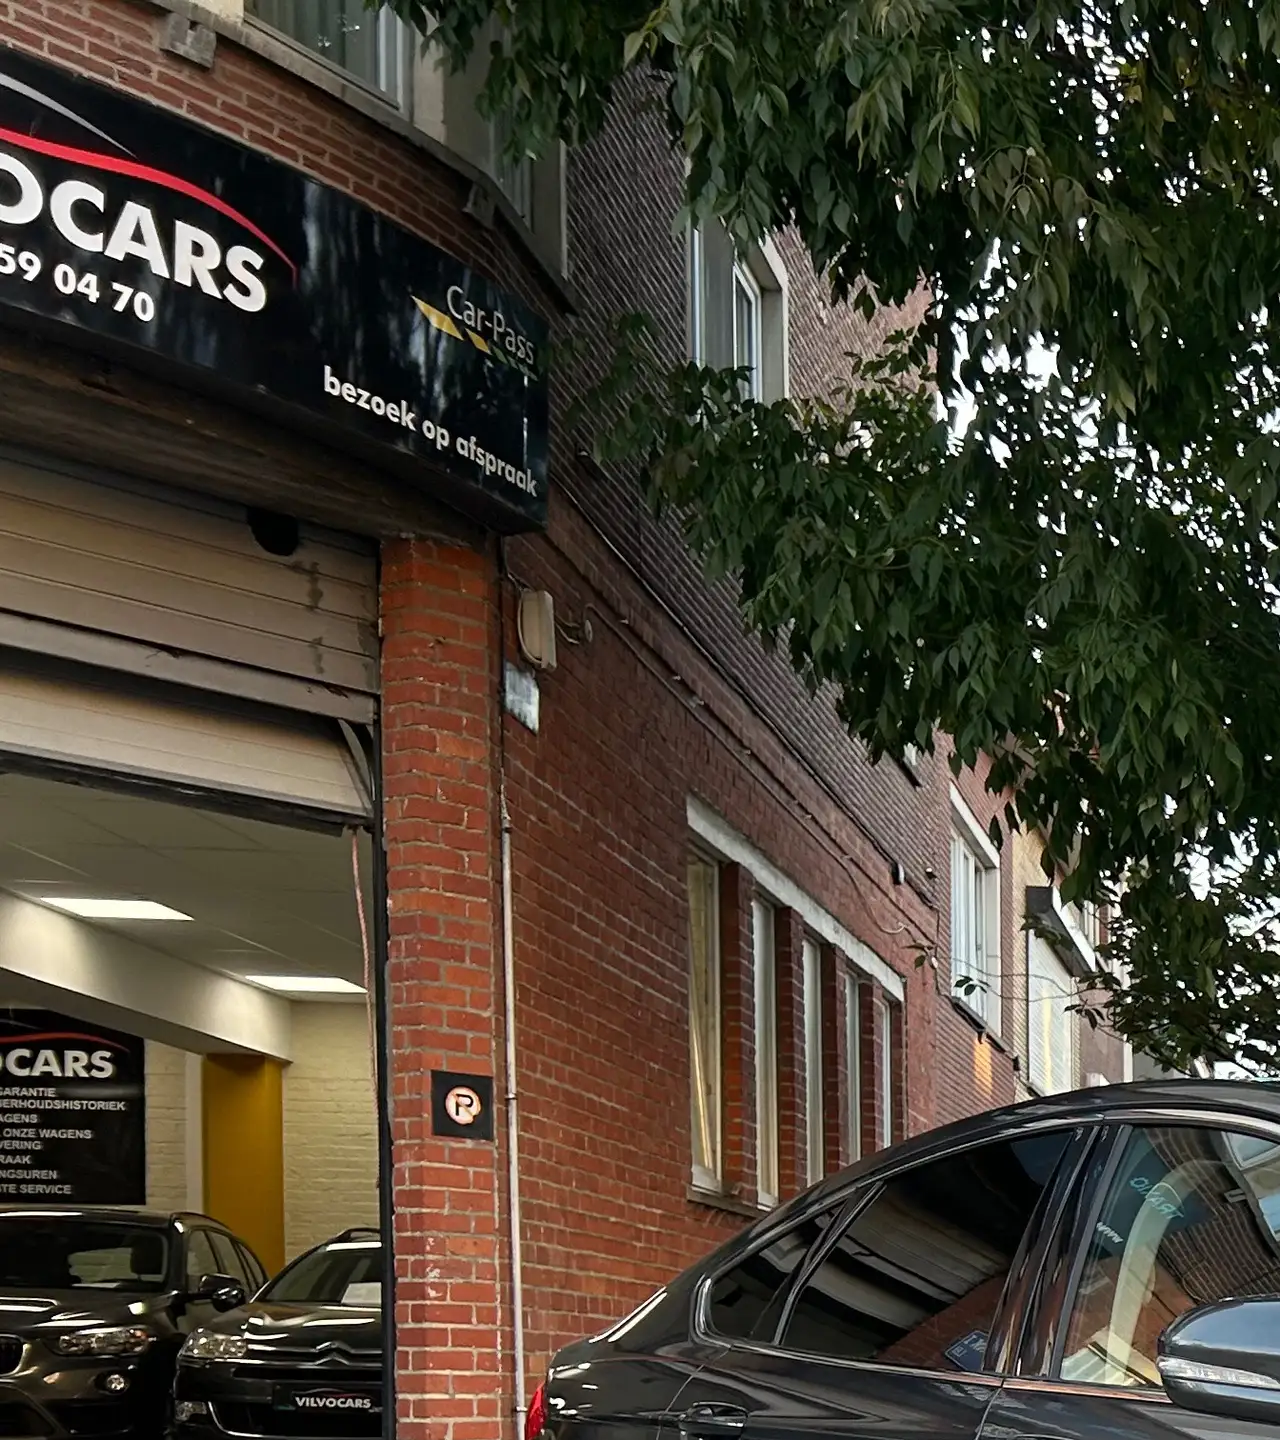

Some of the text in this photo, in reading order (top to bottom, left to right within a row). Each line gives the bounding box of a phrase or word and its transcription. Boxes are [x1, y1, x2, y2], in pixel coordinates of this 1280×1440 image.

[54, 263, 100, 304] 04
[111, 282, 155, 322] 70
[447, 285, 534, 365] Car-Pass
[323, 365, 538, 498] bezoek op afspraak
[0, 1048, 115, 1079] CARS
[0, 1098, 126, 1111] ERHOUDSHISTORIEK
[2, 1128, 92, 1139] ONZE WAGENS
[20, 1184, 72, 1195] SERVICE
[295, 1396, 371, 1409] VILVOCARS
